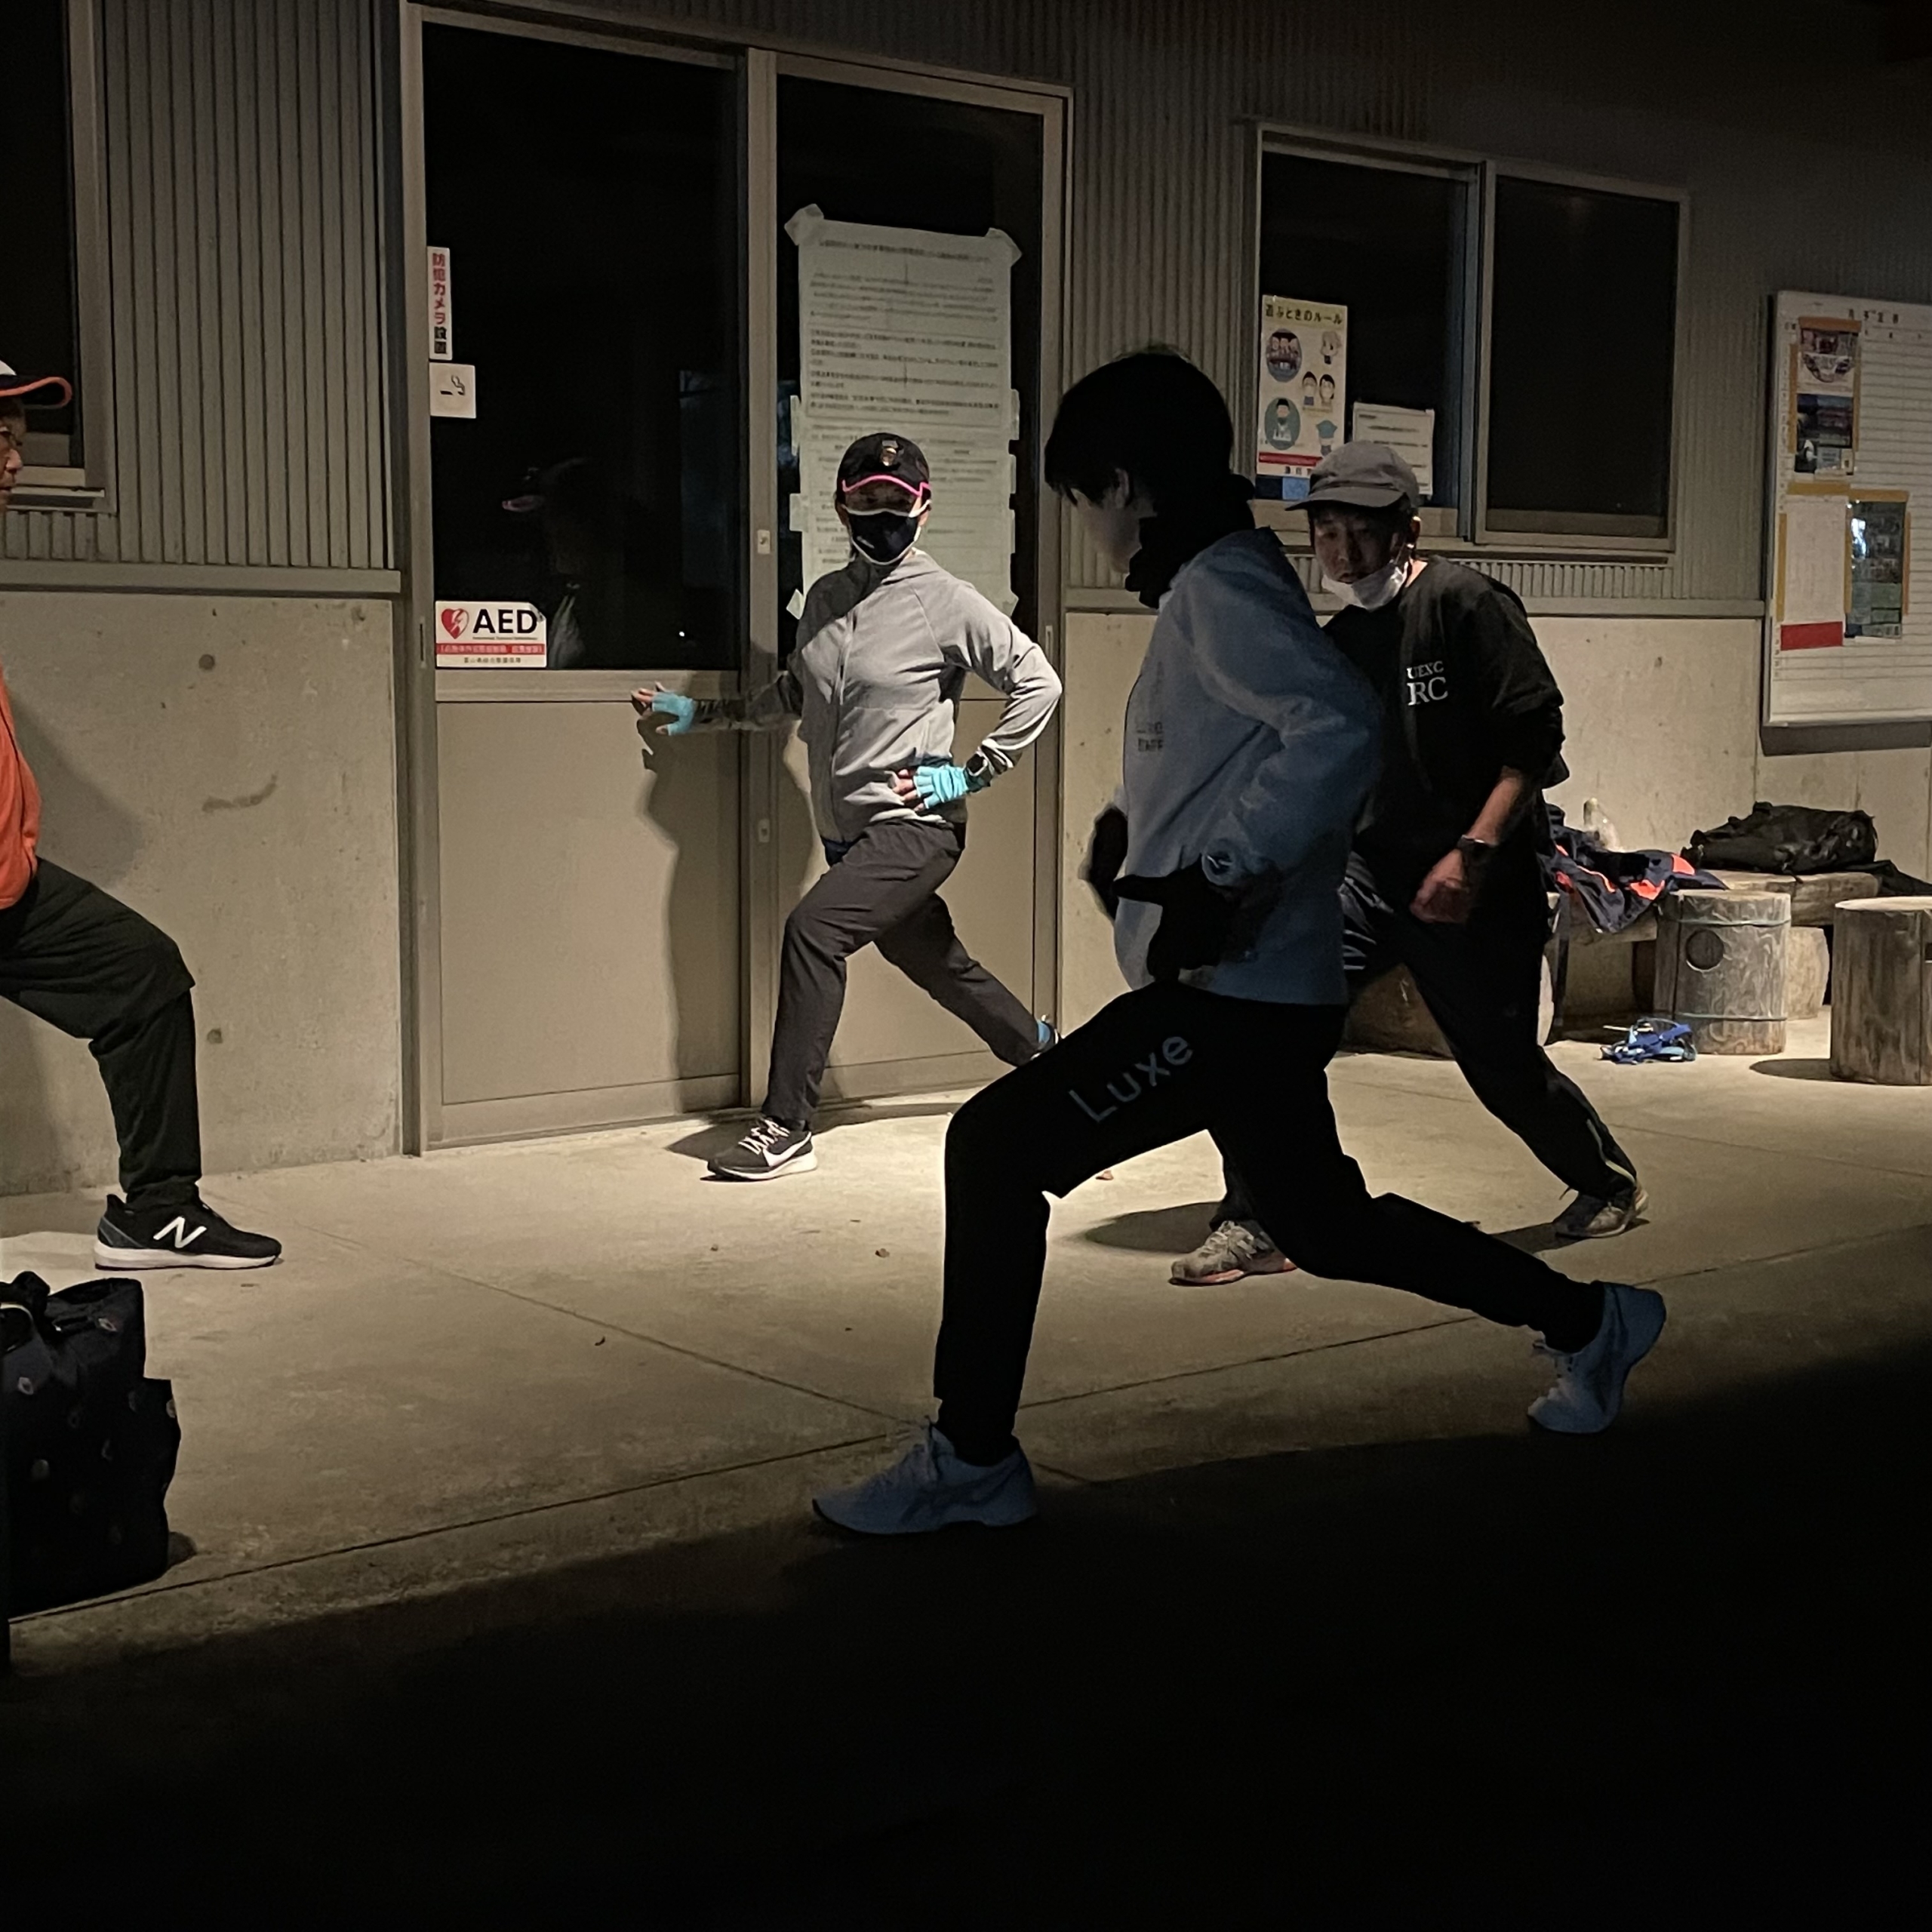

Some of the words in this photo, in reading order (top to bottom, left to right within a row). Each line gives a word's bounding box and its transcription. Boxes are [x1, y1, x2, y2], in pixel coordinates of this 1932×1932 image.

[472, 608, 537, 633] AED
[1406, 676, 1448, 706] RC
[1069, 1036, 1193, 1122] Luxe
